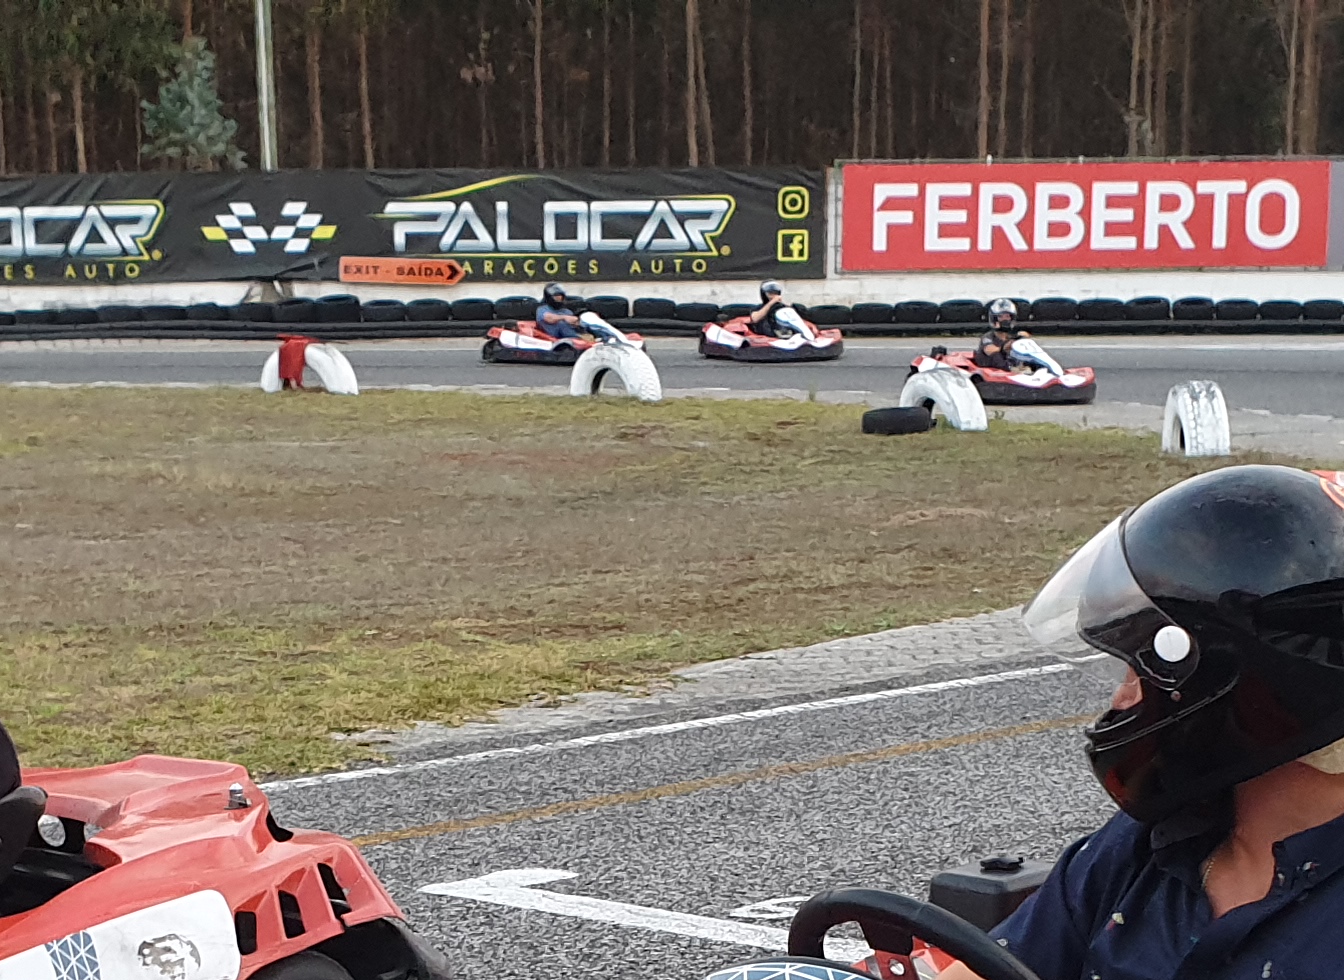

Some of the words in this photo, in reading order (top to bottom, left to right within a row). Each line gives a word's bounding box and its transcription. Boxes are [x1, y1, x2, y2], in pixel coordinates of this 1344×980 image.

[873, 176, 1301, 253] FERBERTO
[384, 200, 733, 252] PALOCAR
[64, 262, 142, 279] AUTO
[343, 265, 380, 275] EXIT
[396, 264, 445, 277] SAÍDA
[462, 257, 600, 277] ARAÇÕES
[630, 258, 708, 276] AUTO
